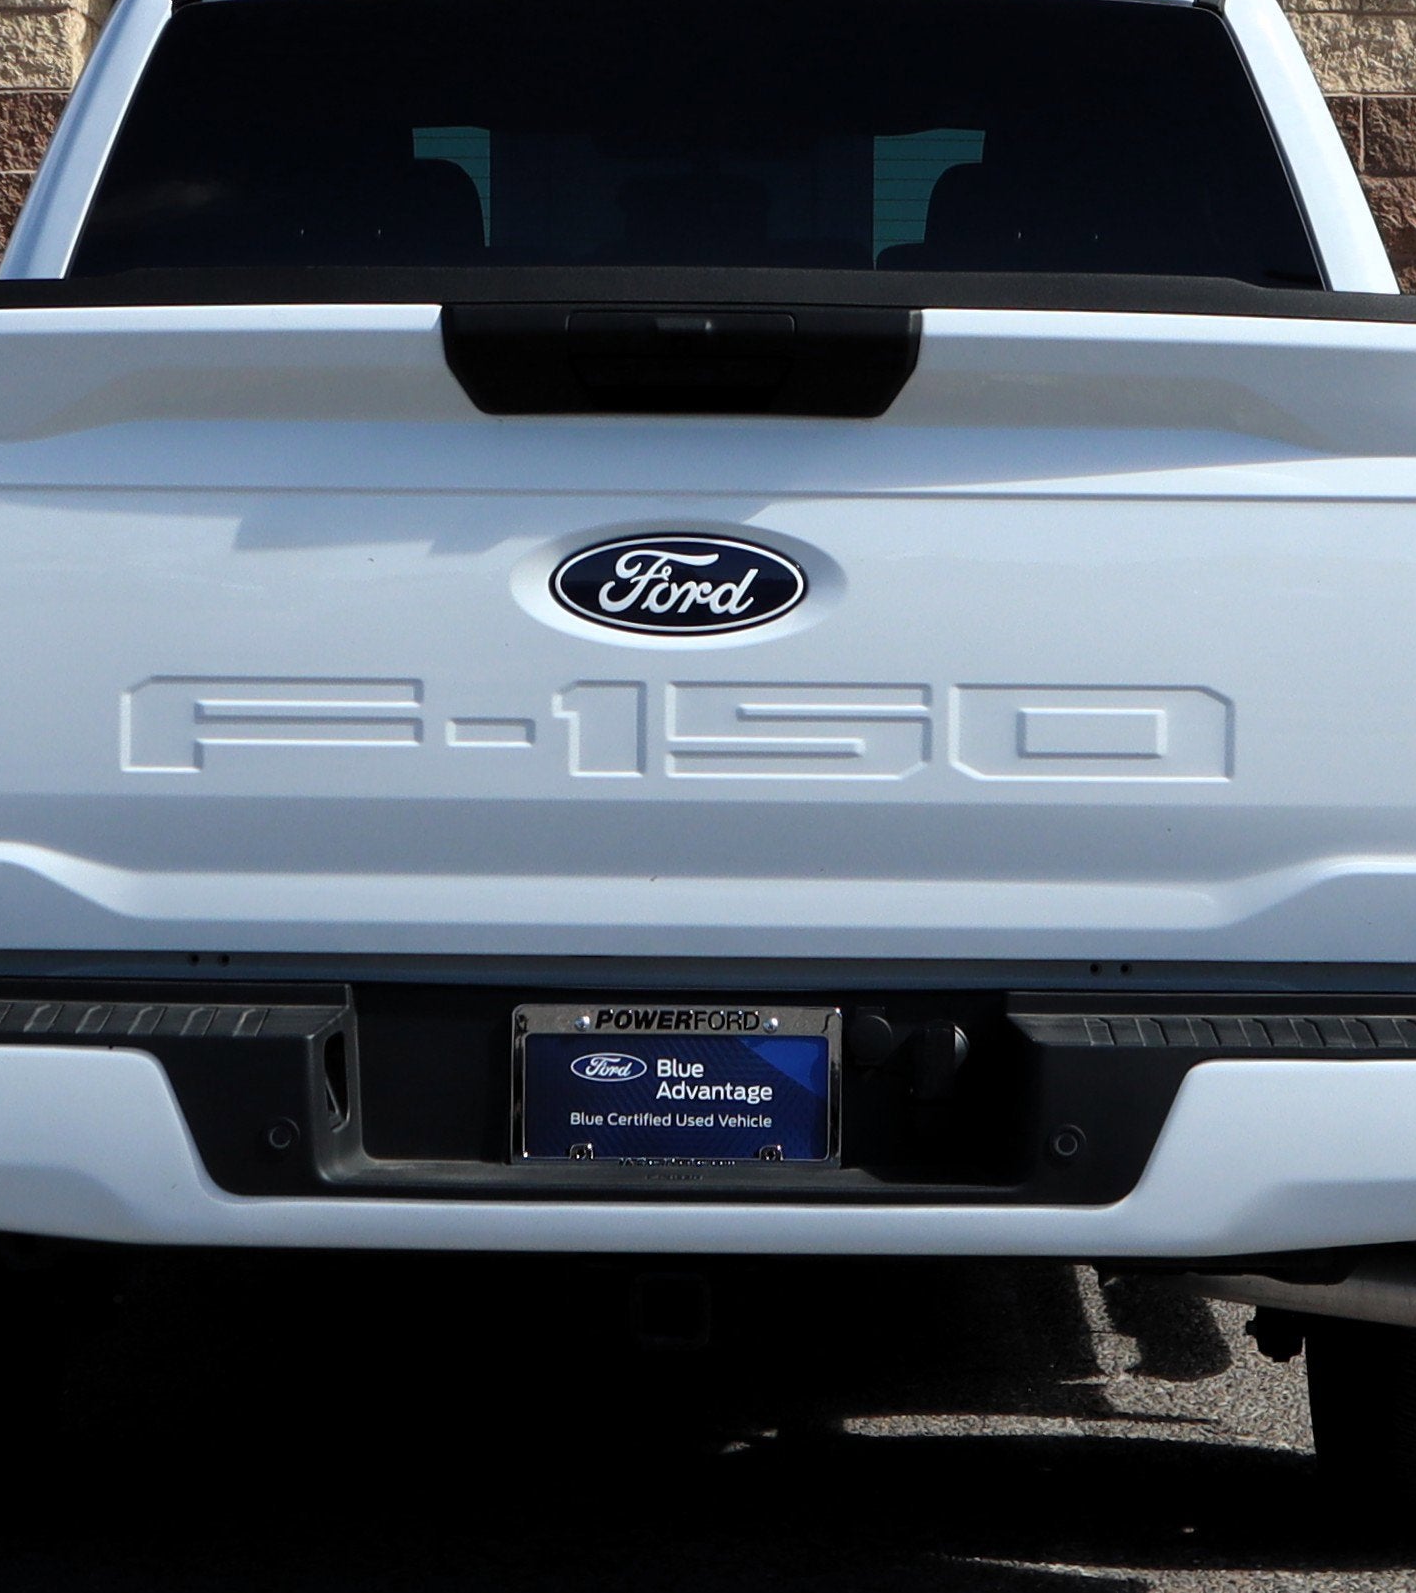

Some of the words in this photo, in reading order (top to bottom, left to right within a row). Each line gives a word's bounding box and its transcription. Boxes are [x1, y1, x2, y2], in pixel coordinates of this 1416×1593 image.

[598, 549, 759, 614] Ford
[120, 675, 1235, 783] F-150
[595, 1009, 761, 1031] POWERFORD
[585, 1057, 633, 1078] Ford
[656, 1059, 704, 1078] Blue
[656, 1081, 773, 1104] Advantage
[570, 1112, 604, 1126] Blue
[607, 1112, 672, 1127] Certified
[675, 1113, 714, 1128] Used
[718, 1114, 773, 1129] Vehicle
